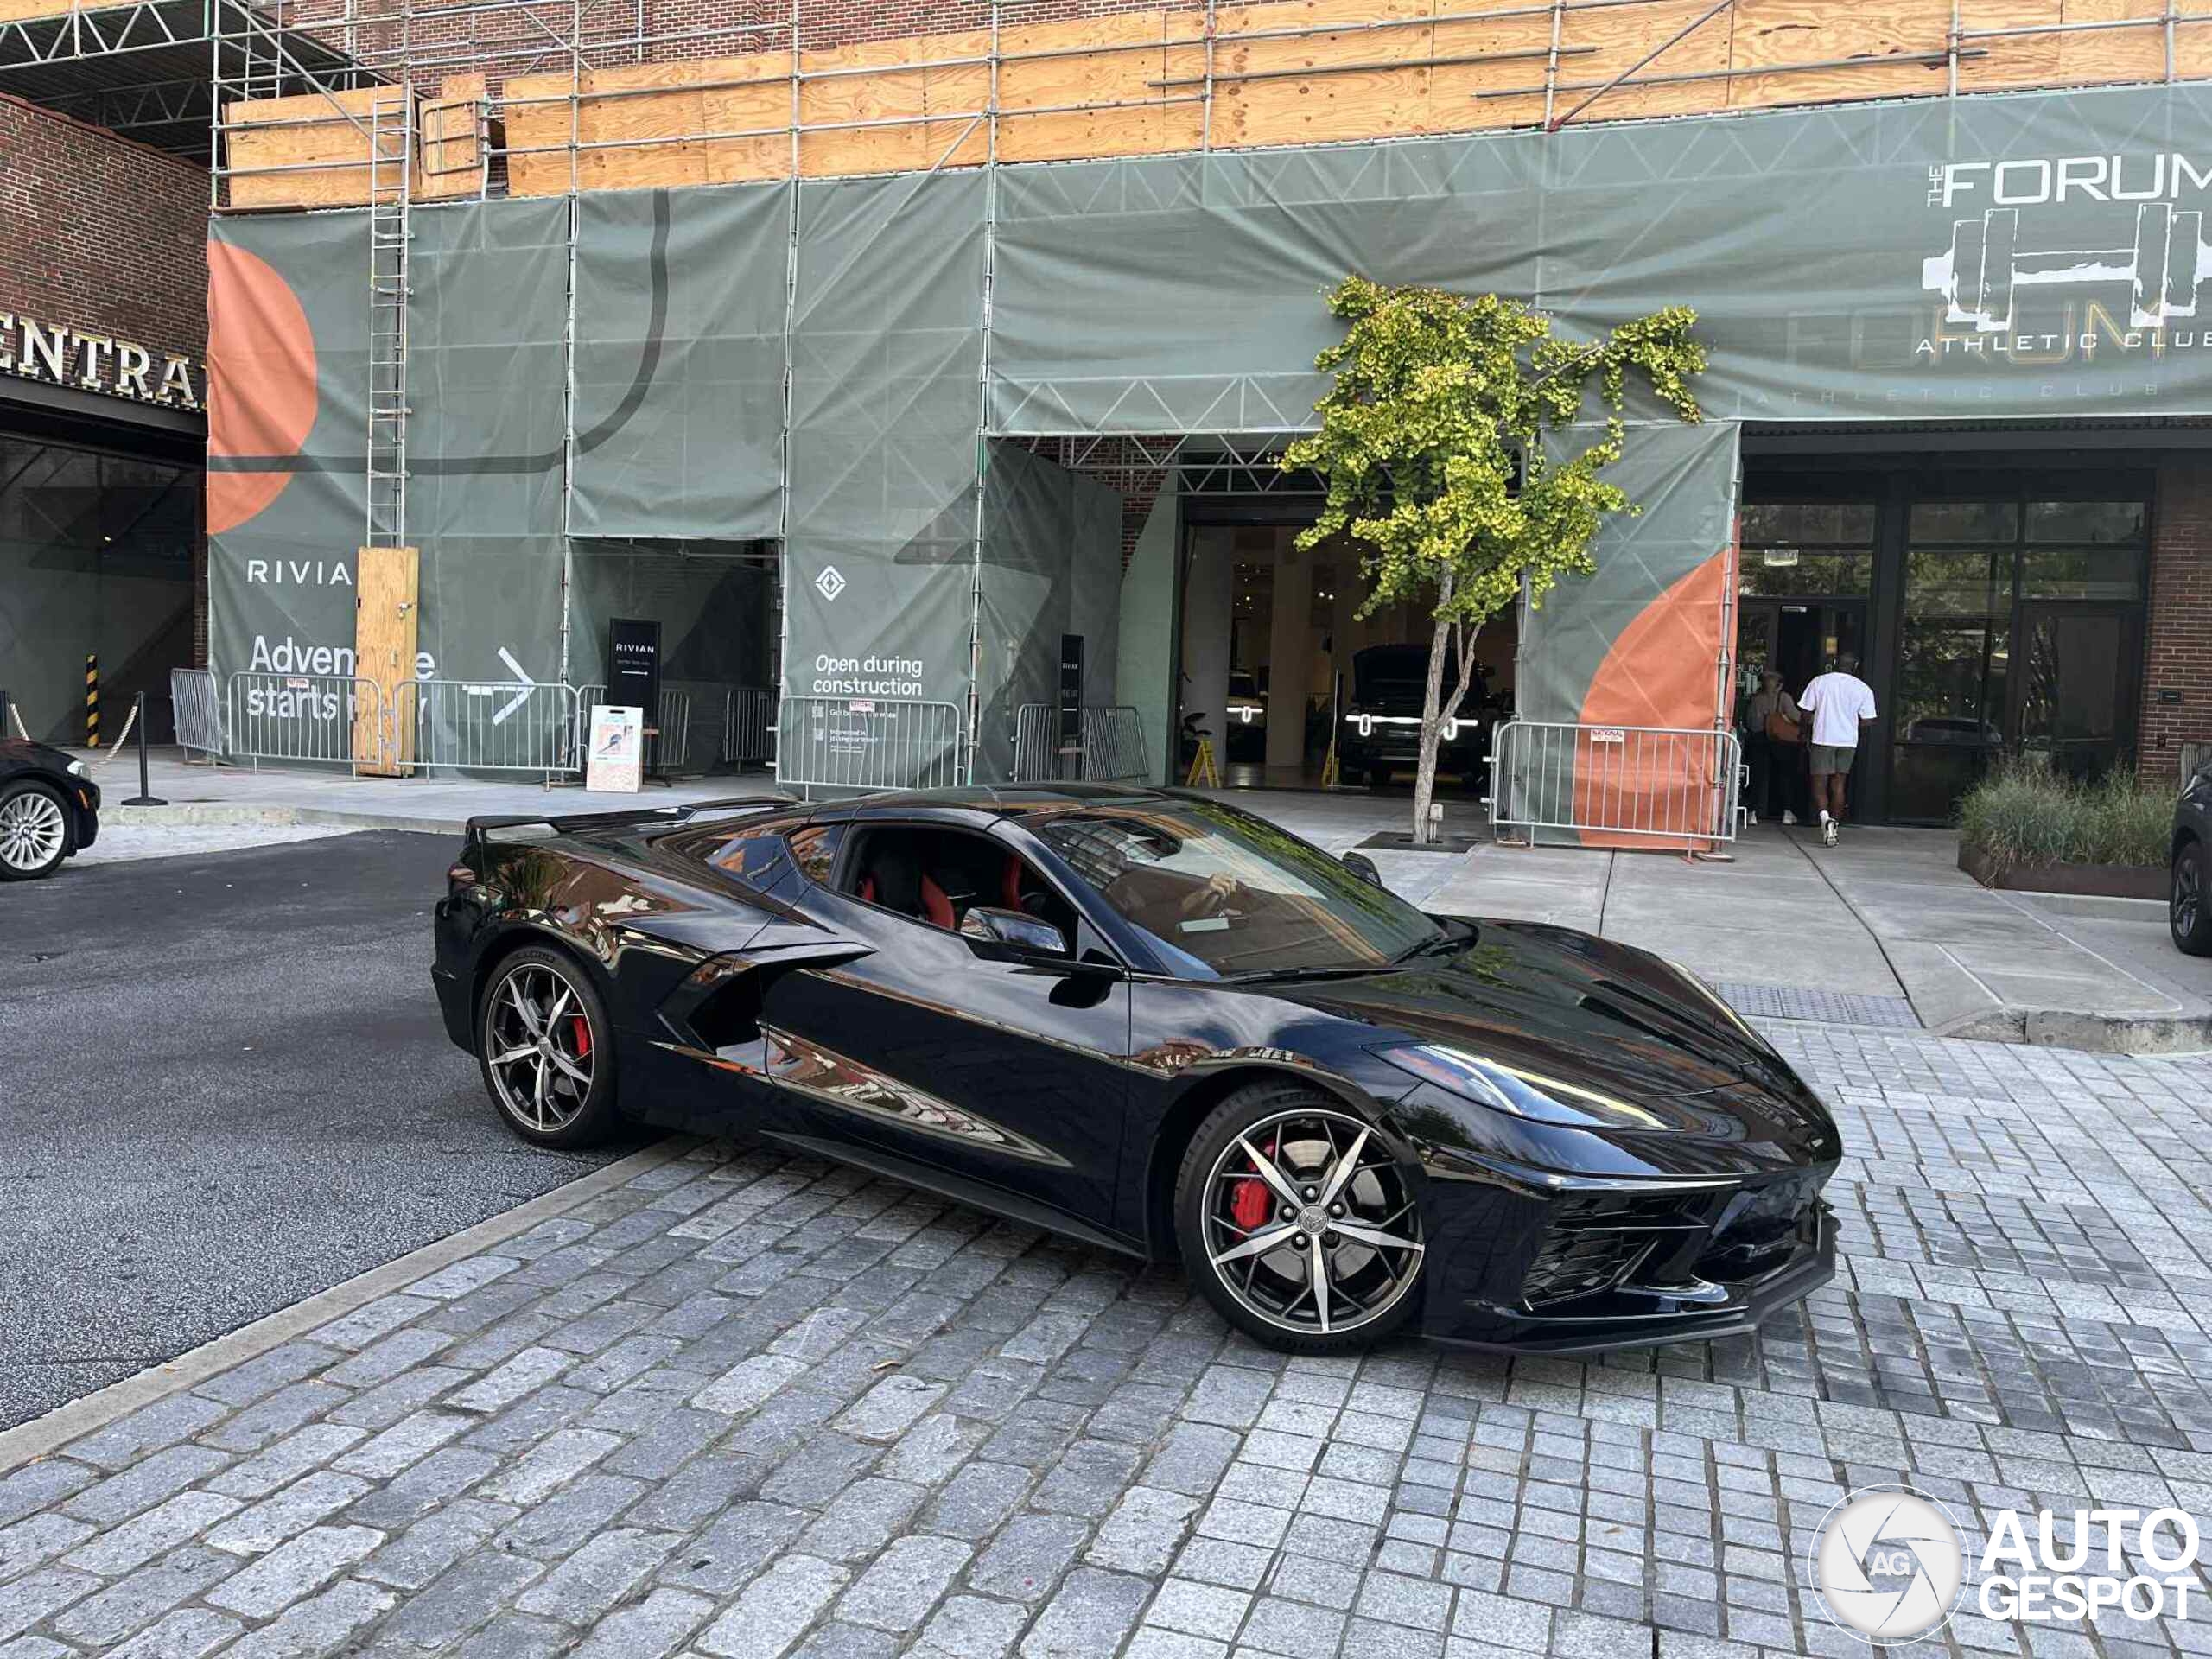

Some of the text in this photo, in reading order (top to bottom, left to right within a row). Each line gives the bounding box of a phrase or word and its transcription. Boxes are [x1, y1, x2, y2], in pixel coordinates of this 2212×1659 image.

[1927, 164, 1944, 207] THE
[1943, 154, 2212, 207] FORUM
[1915, 333, 2098, 354] ATHLETIC
[0, 312, 208, 410] NTRA
[247, 560, 353, 586] RIVIA
[249, 635, 435, 681] Advene
[615, 643, 654, 653] RIVIAN
[815, 654, 923, 678] Open during
[246, 682, 338, 721] starts
[813, 677, 923, 696] construction
